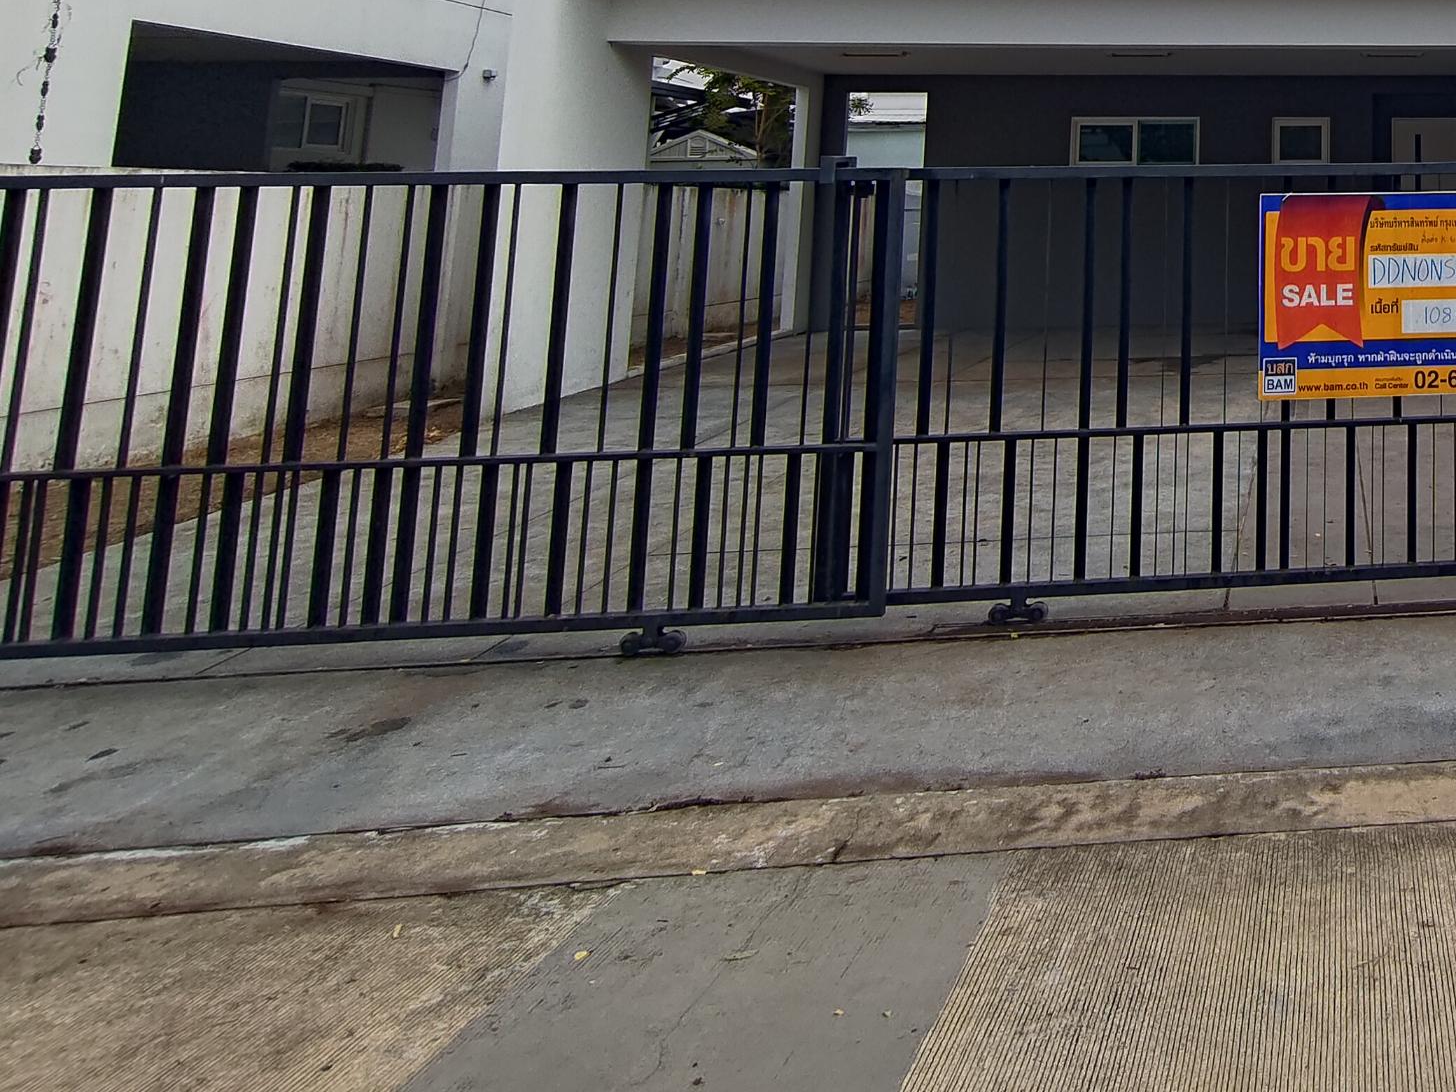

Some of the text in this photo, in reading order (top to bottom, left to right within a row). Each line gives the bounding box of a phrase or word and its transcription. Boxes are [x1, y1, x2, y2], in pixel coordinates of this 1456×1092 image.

[1280, 236, 1355, 271] ขาย
[1281, 283, 1354, 308] SALE
[1370, 298, 1399, 315] เนื้อที่
[1307, 352, 1354, 367] ห้ามบุกรุก
[1266, 361, 1294, 375] บสก
[1266, 378, 1294, 391] BAM
[1298, 381, 1369, 393] www.bam.co.th
[1374, 381, 1409, 390] Call Center
